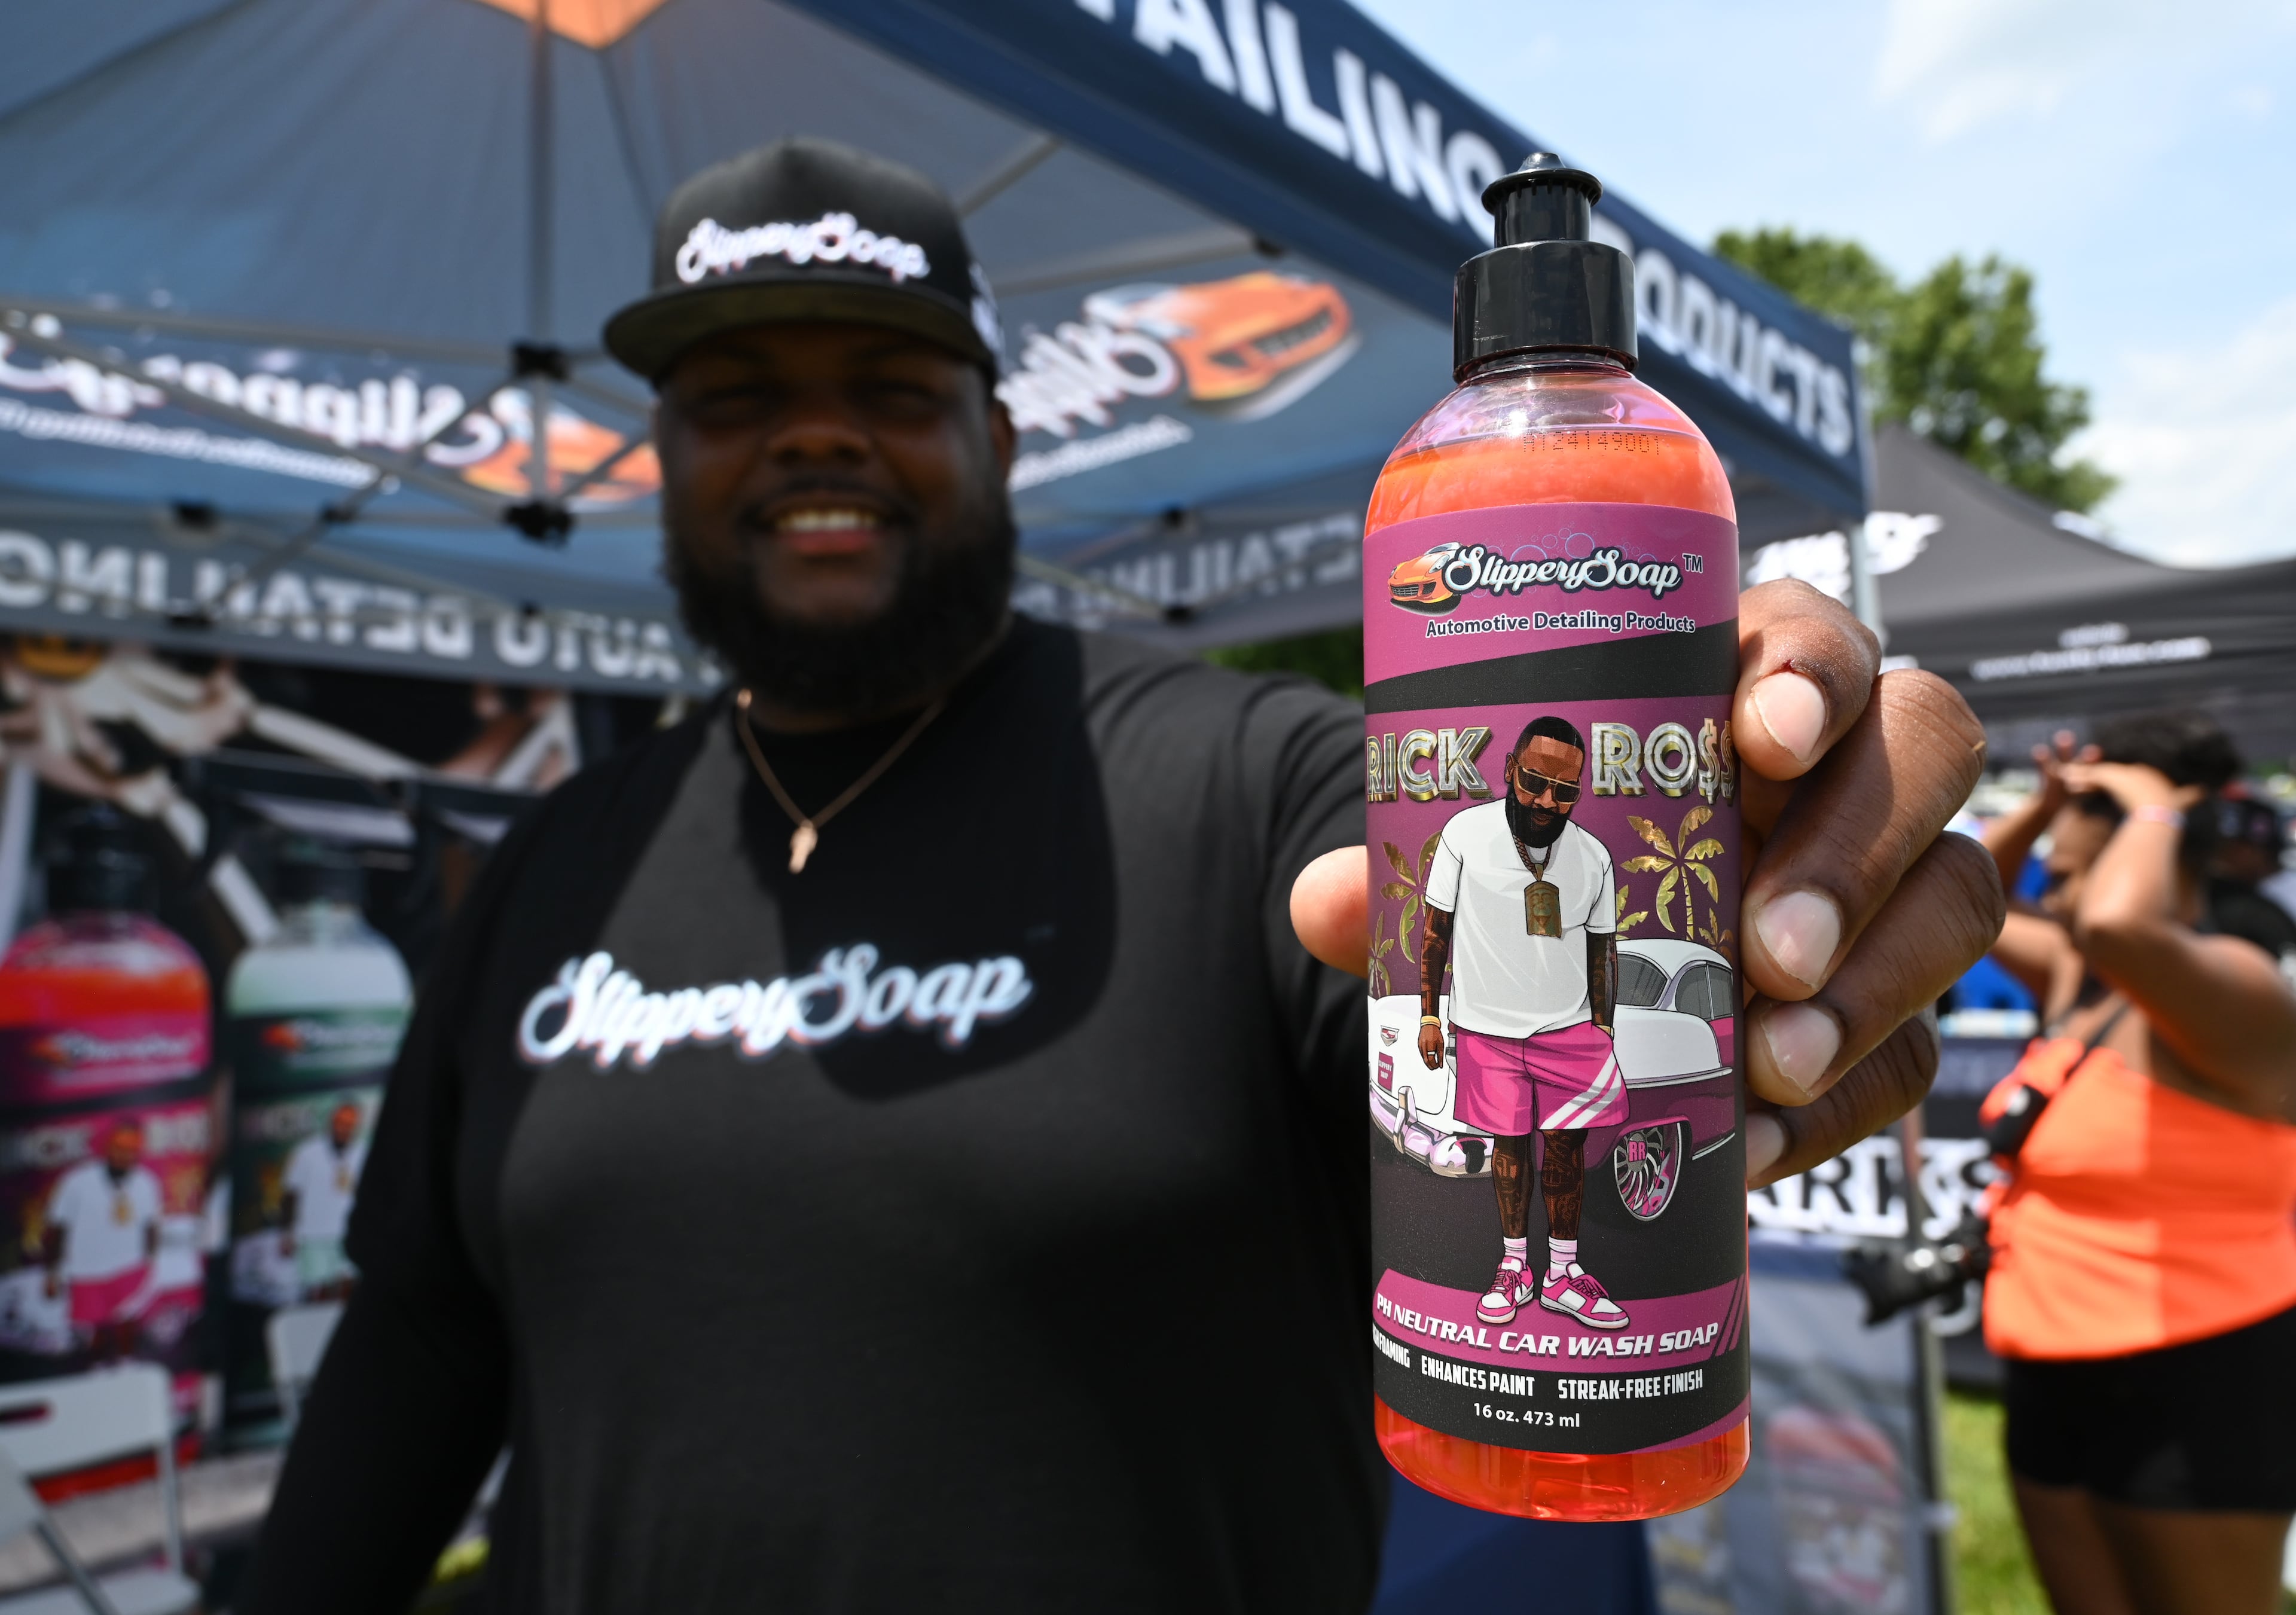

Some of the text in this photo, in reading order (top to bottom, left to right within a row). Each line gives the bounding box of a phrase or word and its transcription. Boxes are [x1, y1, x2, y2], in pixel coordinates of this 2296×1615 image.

[1445, 547, 1703, 596] SlipperySoap TM
[1425, 611, 1696, 637] Automotive Detailing Products
[1367, 726, 1493, 802] RICK
[518, 943, 1034, 1068] SlipperySoap
[1629, 1141, 1645, 1162] RR
[1376, 1292, 1718, 1357] PH NEUTRAL CAR WASH SOAP
[1379, 1331, 1410, 1369] FOAMING
[1421, 1354, 1486, 1390] ENHANCES
[1489, 1371, 1535, 1397] PAINT
[1558, 1377, 1661, 1400] STREAK-FREE
[1664, 1368, 1703, 1396] FINISH
[1474, 1402, 1580, 1427] 16 oz. 473 ml
